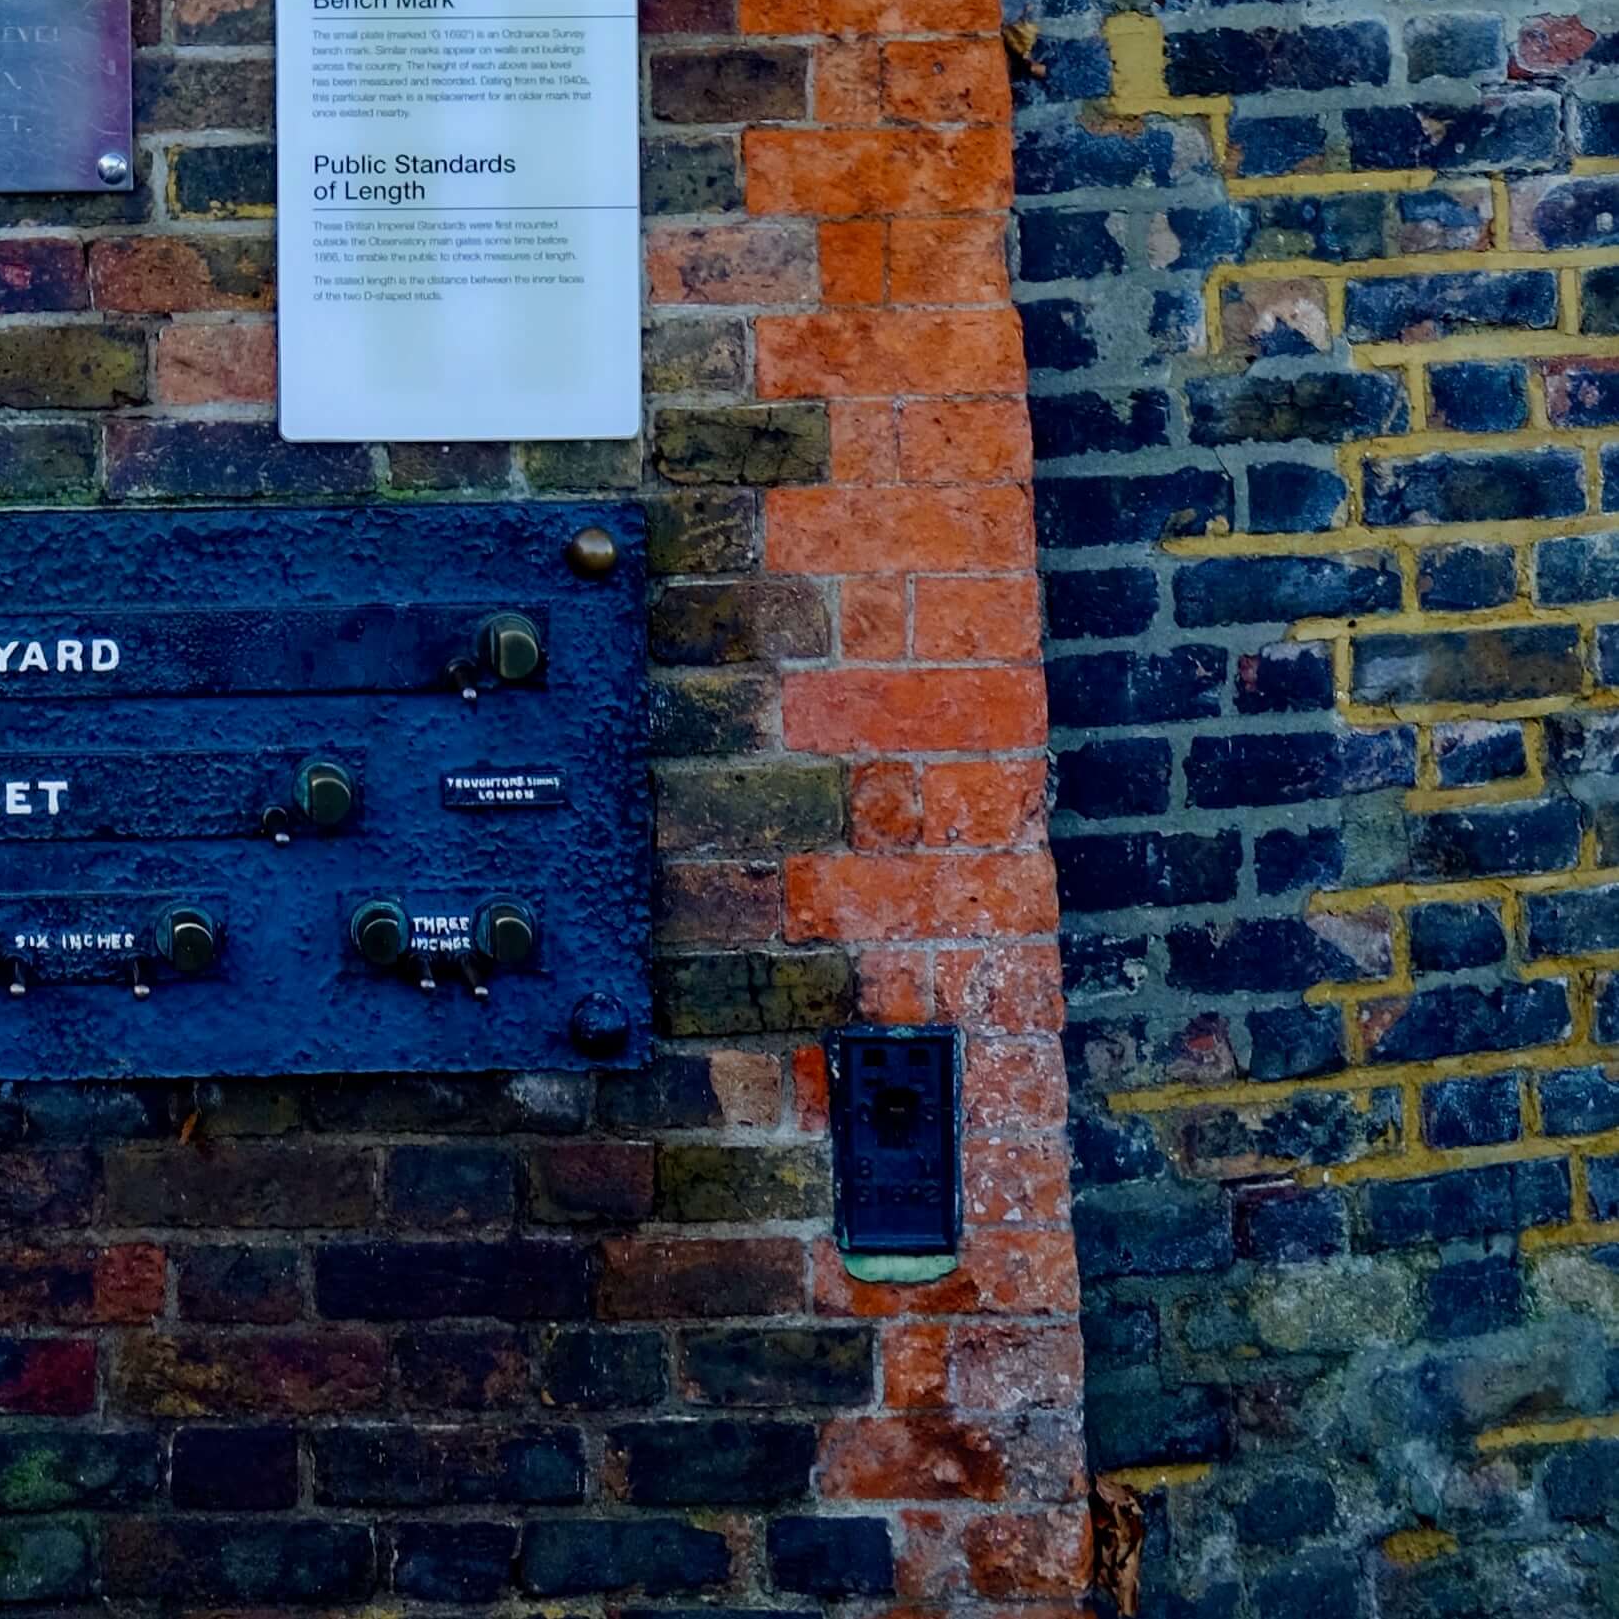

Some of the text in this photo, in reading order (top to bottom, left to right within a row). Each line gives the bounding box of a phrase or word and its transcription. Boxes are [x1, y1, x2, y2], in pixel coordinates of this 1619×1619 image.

[314, 153, 516, 175] Public Standards
[313, 180, 425, 205] of Length
[412, 916, 471, 935] THREE
[14, 932, 136, 950] SIX INCHES
